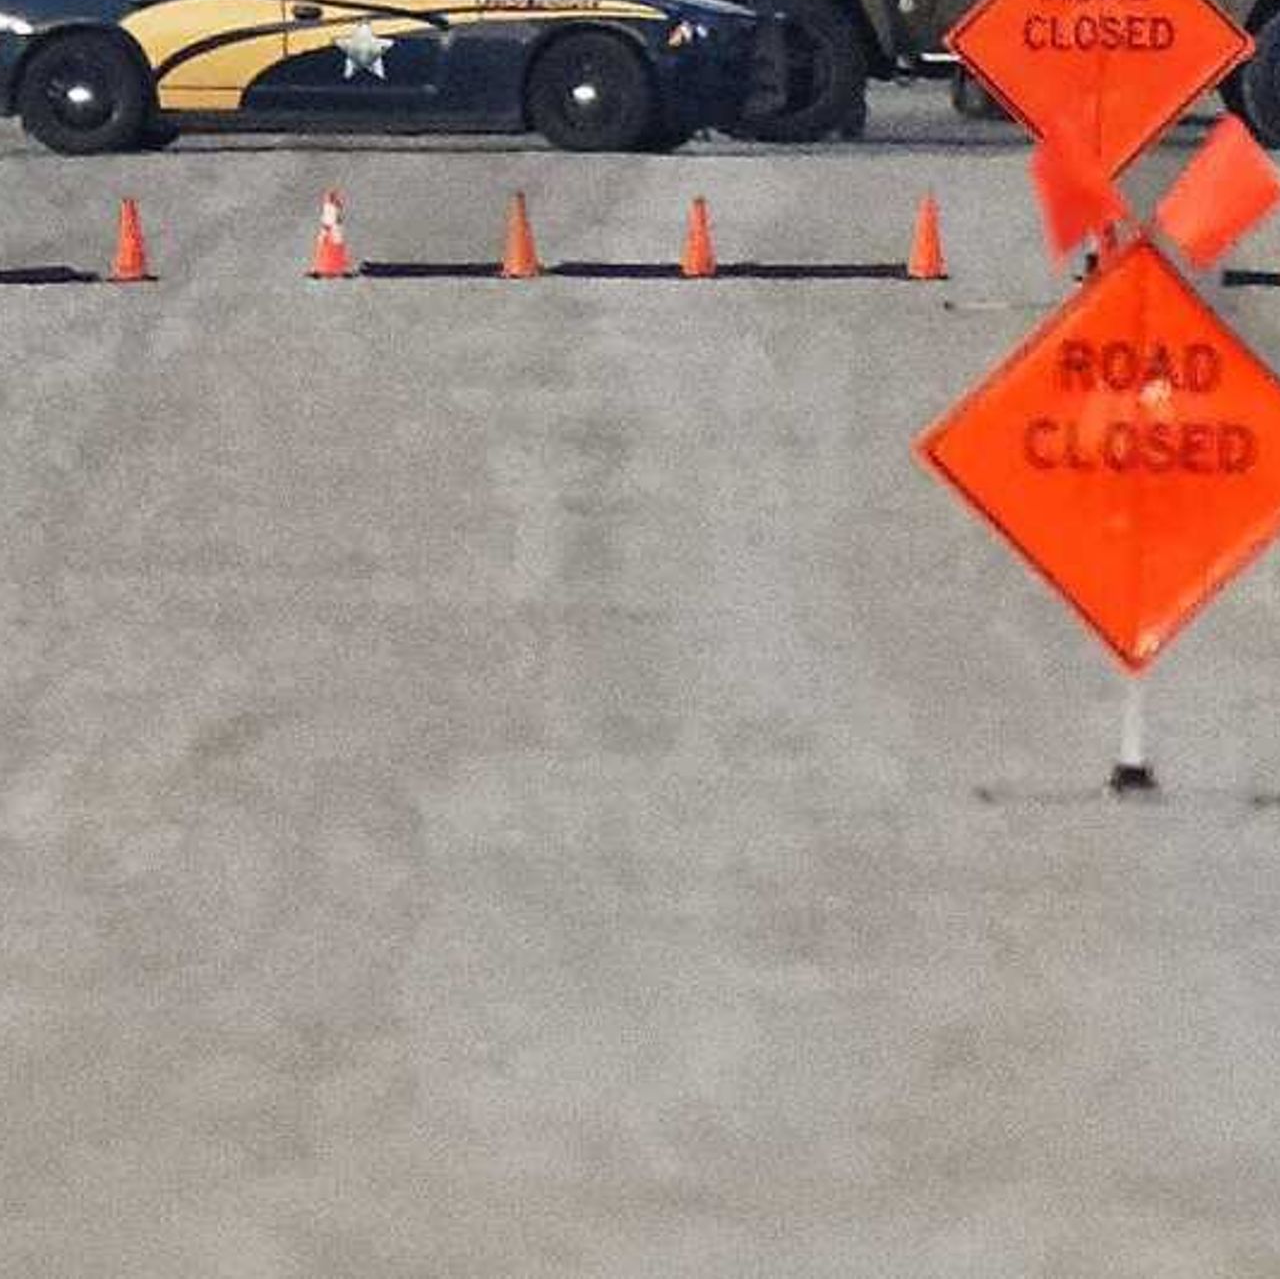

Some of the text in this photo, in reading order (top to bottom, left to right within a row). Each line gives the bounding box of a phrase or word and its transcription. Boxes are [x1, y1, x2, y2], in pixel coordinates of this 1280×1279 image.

[1023, 15, 1175, 51] CLOSED
[1058, 339, 1224, 391] ROAD
[1023, 419, 1259, 474] CLOSED
